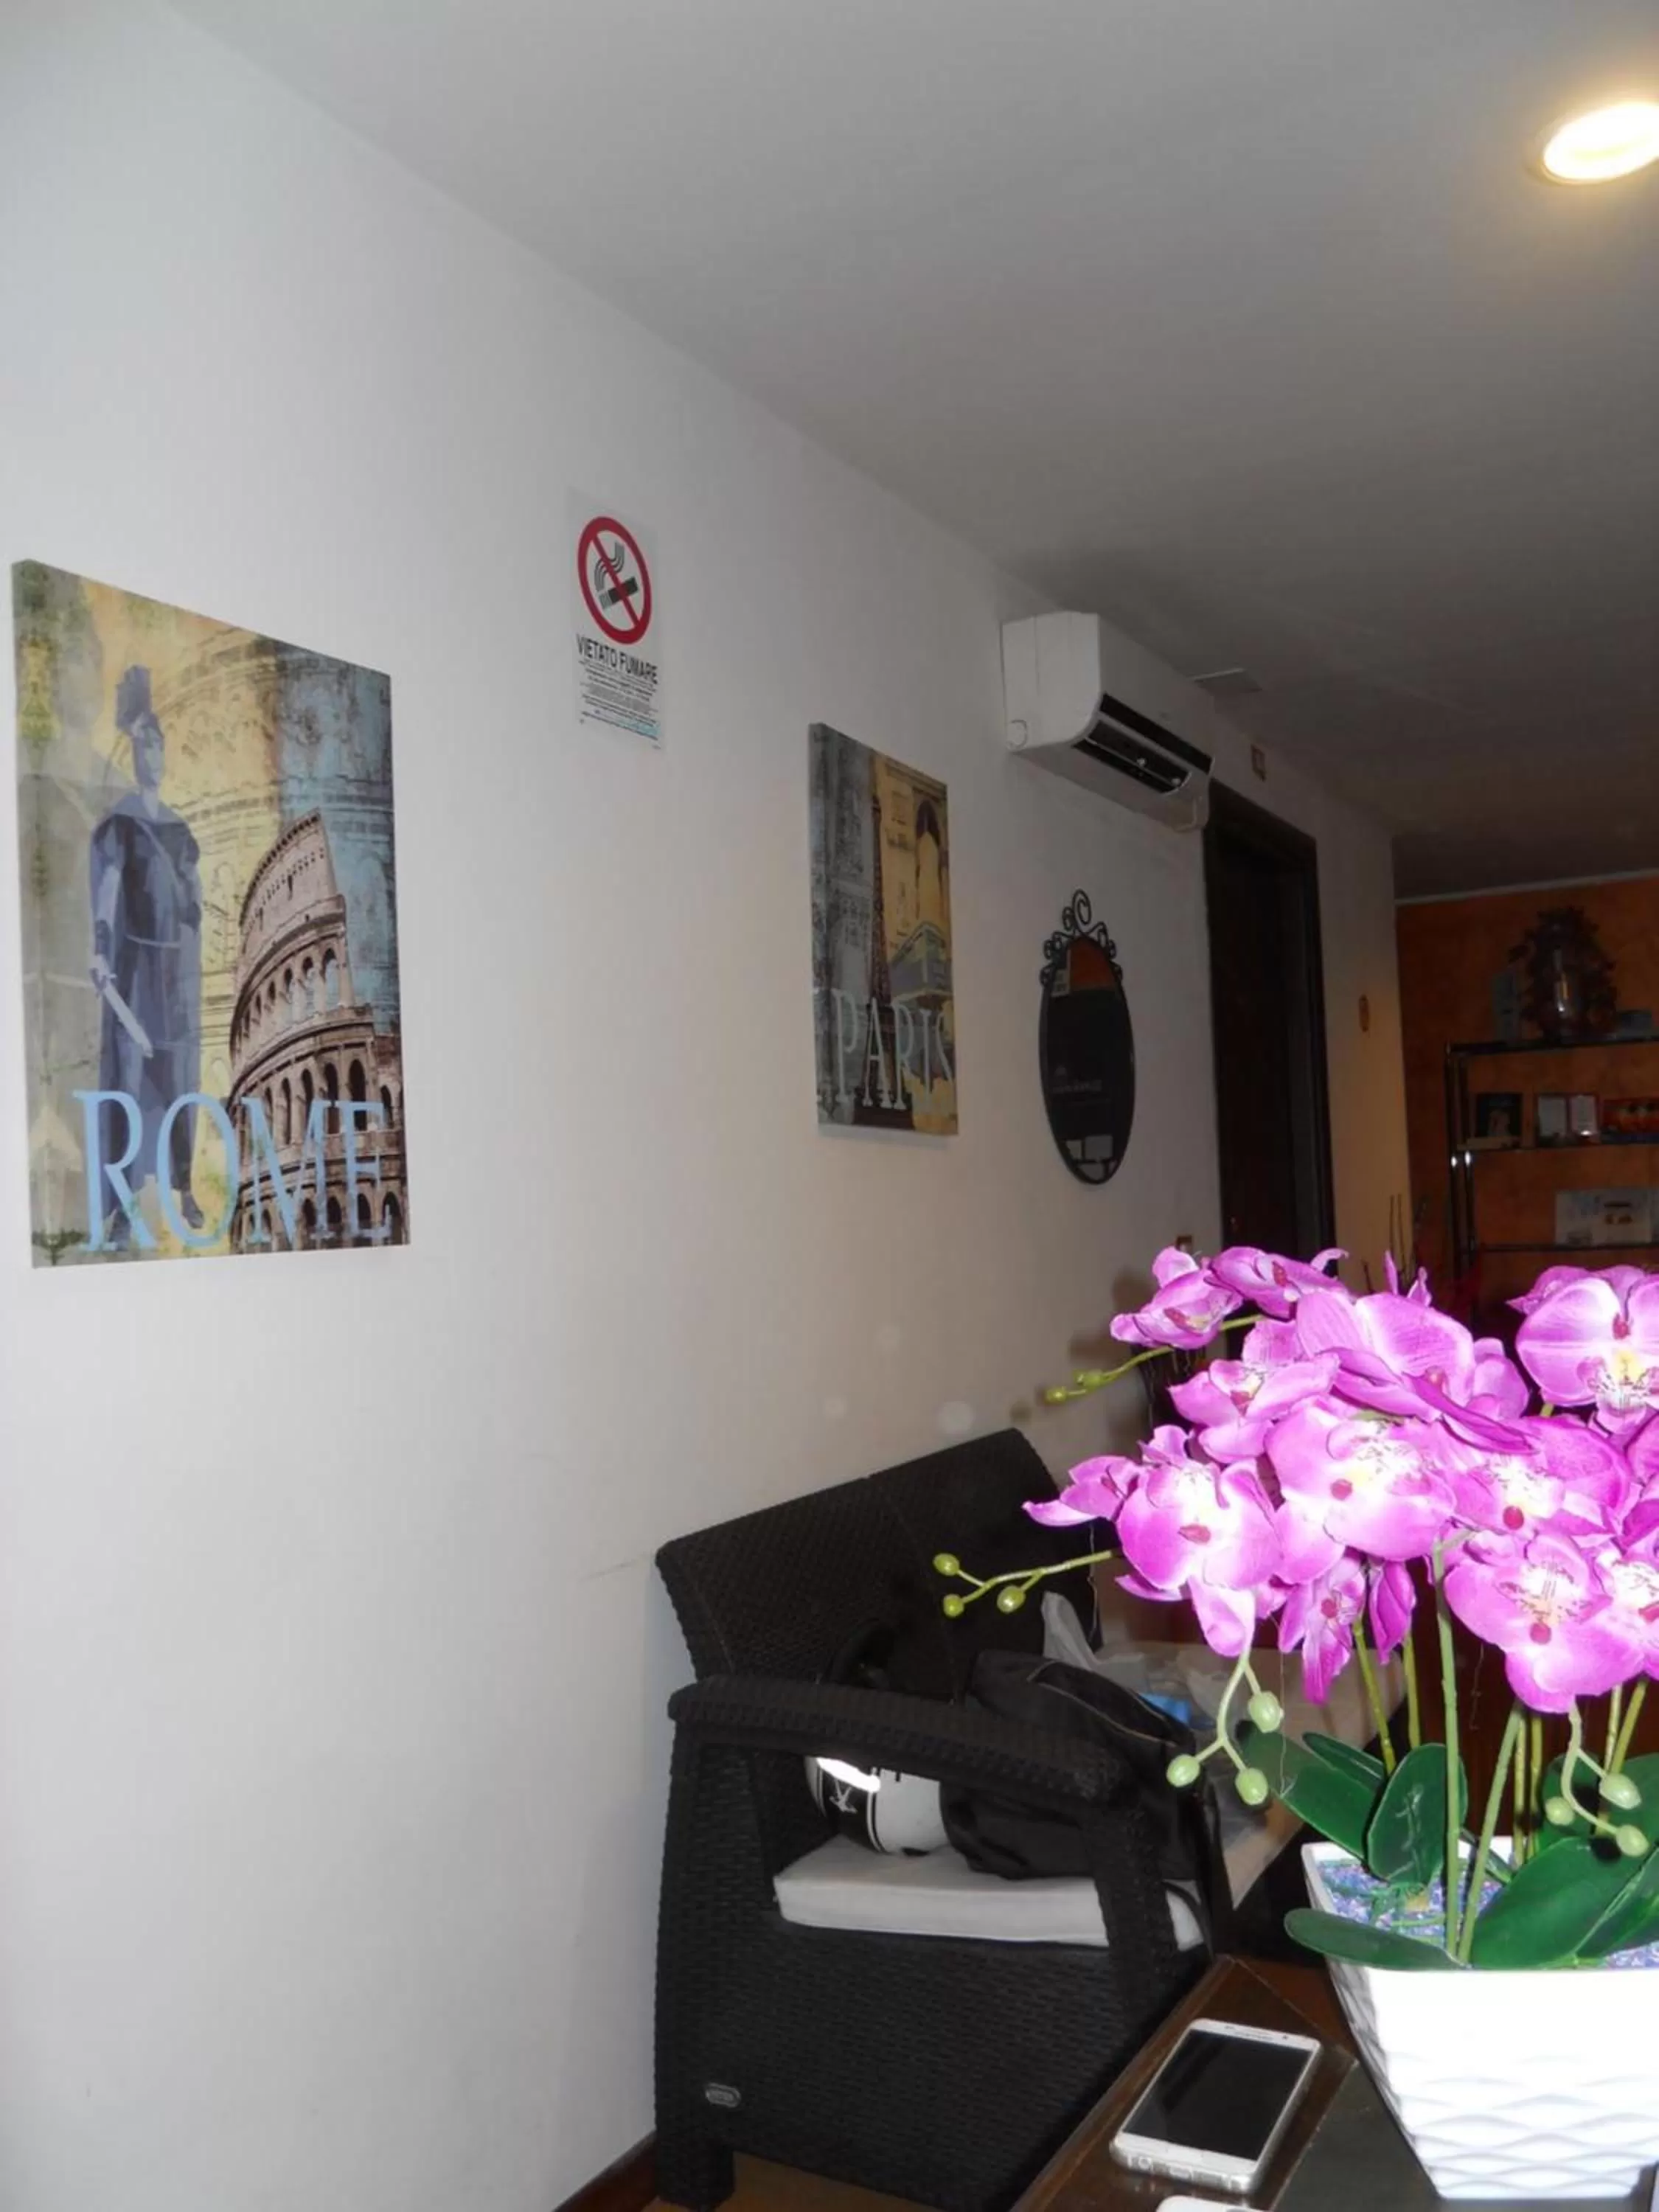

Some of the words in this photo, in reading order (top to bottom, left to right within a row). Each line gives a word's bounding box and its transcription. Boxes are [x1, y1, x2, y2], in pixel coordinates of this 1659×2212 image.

[576, 633, 618, 667] VIETATO
[619, 651, 658, 685] FUMARE
[831, 988, 956, 1110] PARIS
[72, 1090, 393, 1251] ROME
